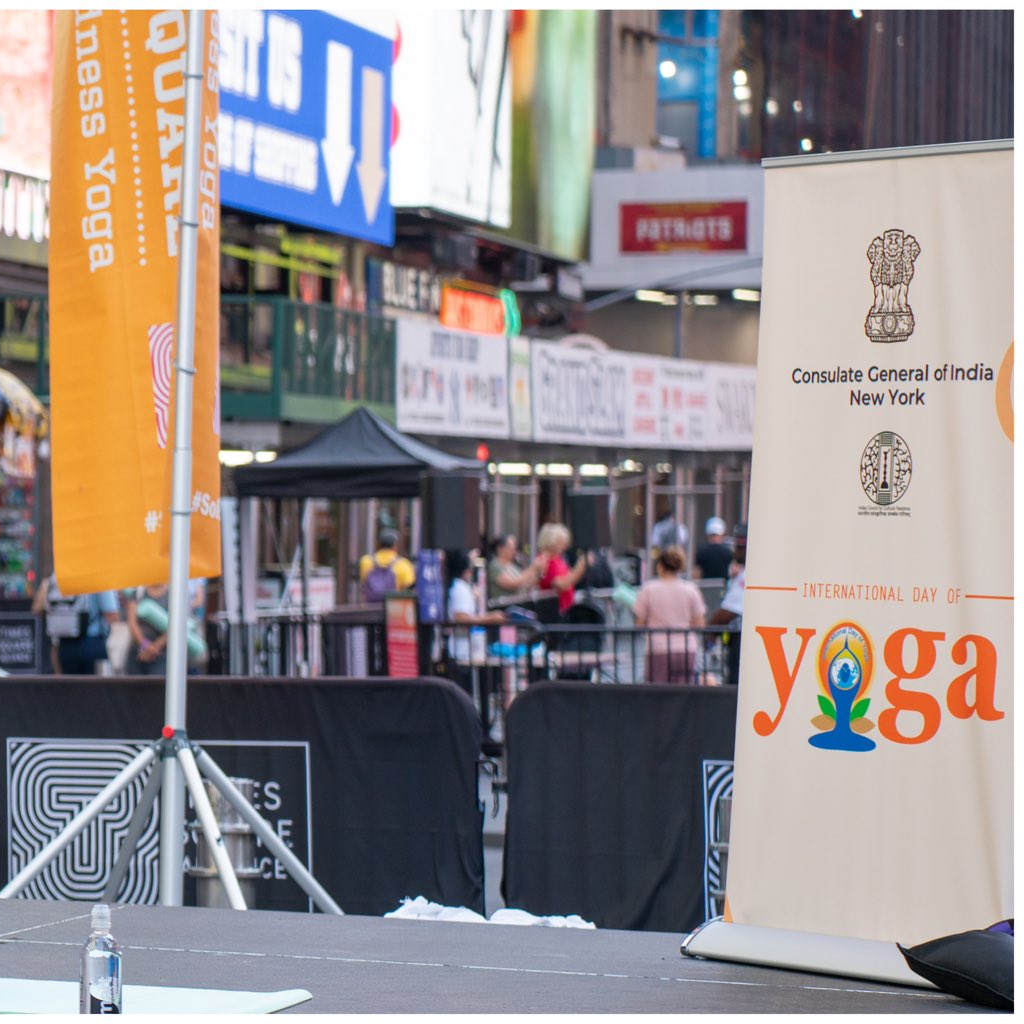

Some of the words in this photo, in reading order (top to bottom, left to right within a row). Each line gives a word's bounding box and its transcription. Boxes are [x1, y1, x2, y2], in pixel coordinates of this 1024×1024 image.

[82, 148, 117, 273] Yoga
[791, 366, 863, 384] Consulate
[867, 364, 929, 383] General
[933, 363, 948, 382] of
[950, 363, 994, 382] India
[849, 389, 884, 406] New
[888, 387, 926, 406] York
[803, 582, 905, 602] INTERNATIONAL
[912, 586, 938, 604] DAY
[947, 588, 962, 604] OF
